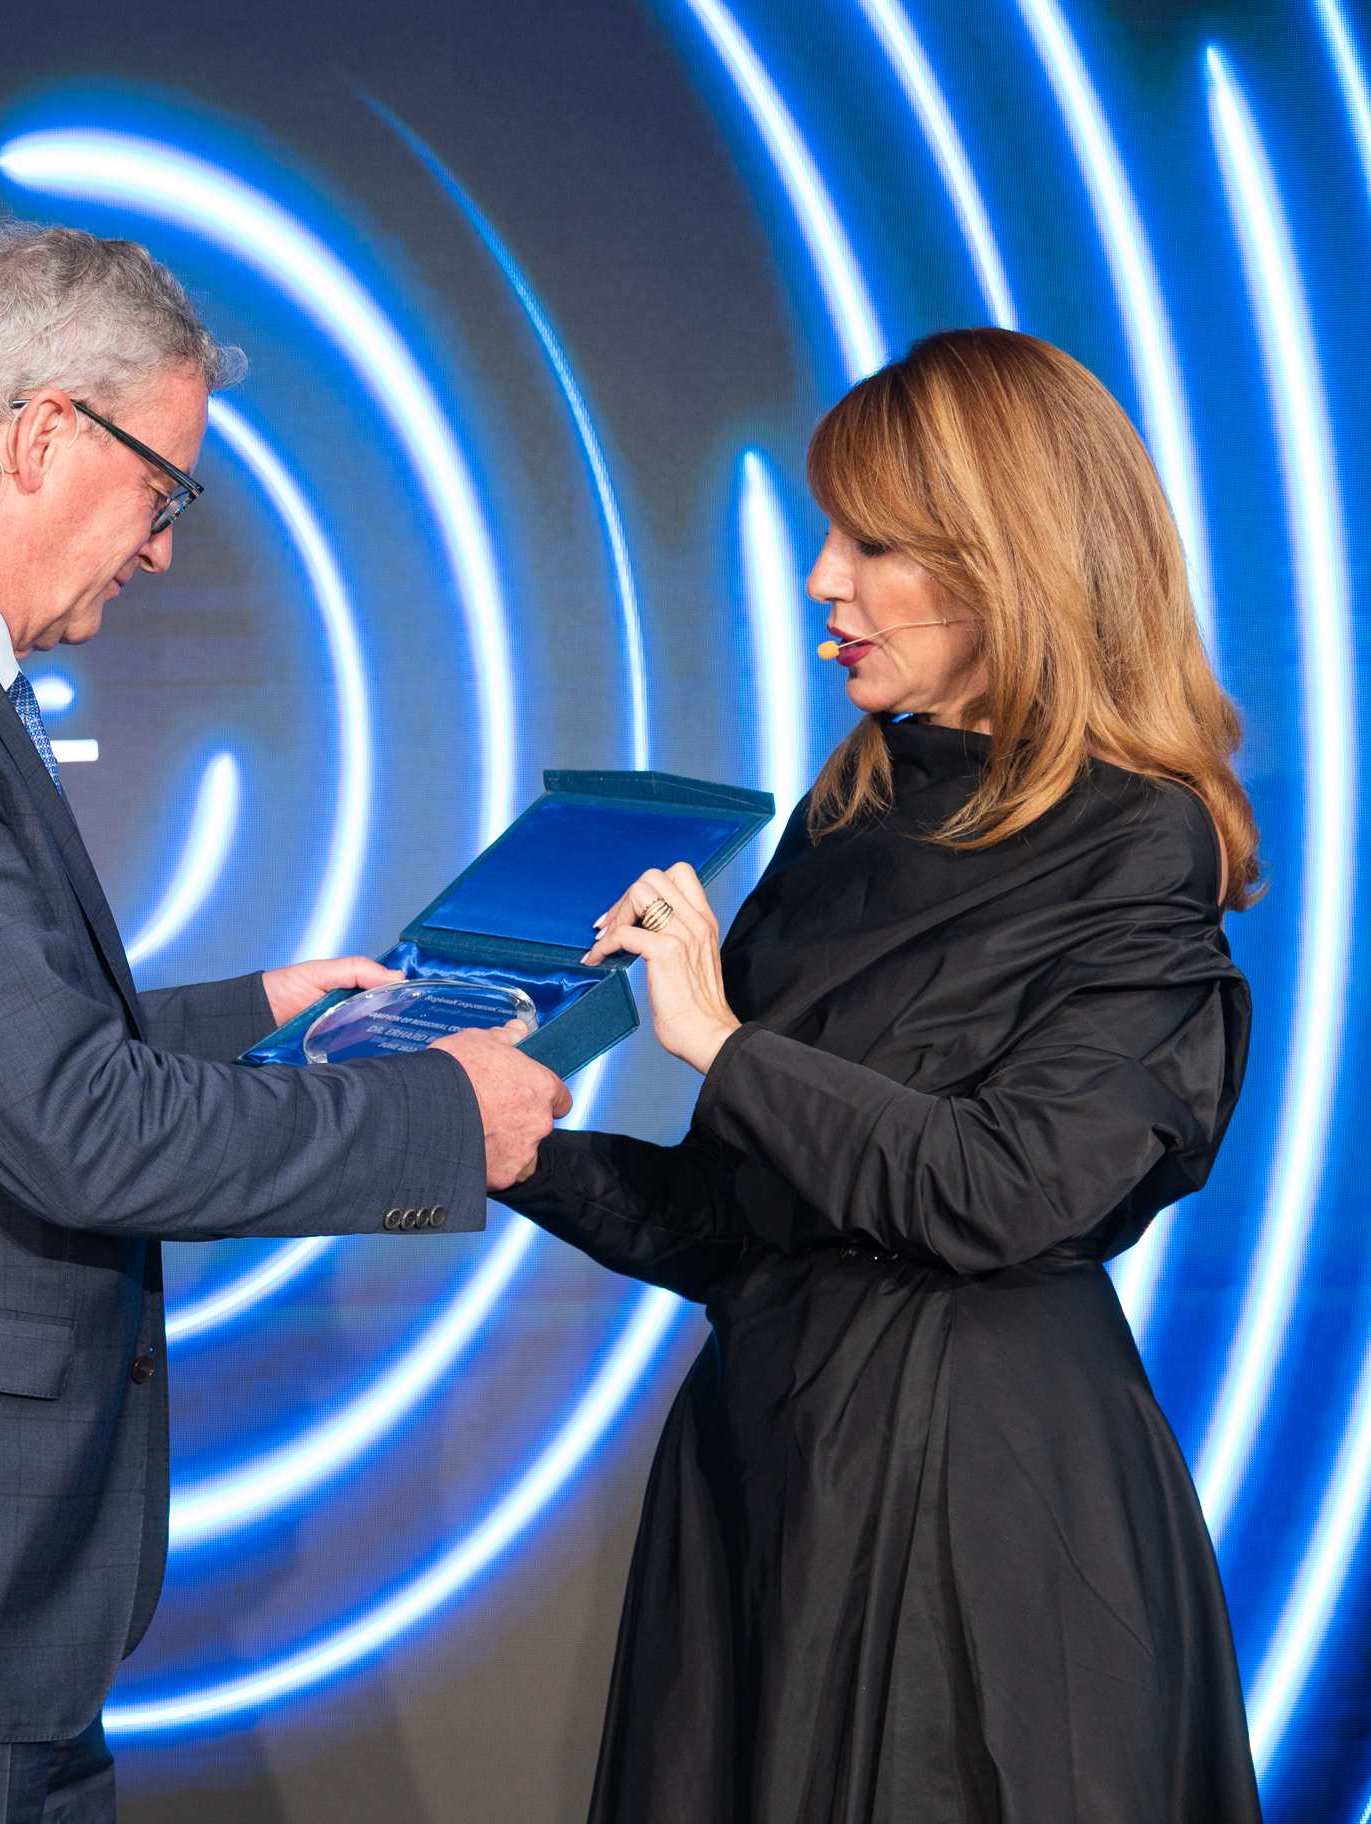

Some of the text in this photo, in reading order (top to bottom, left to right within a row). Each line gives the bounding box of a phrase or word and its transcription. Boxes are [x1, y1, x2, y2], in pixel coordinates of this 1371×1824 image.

[400, 1017, 413, 1025] OF
[410, 1018, 448, 1031] REGIONAL
[366, 1024, 384, 1034] DR.
[384, 1028, 427, 1042] ERHARD
